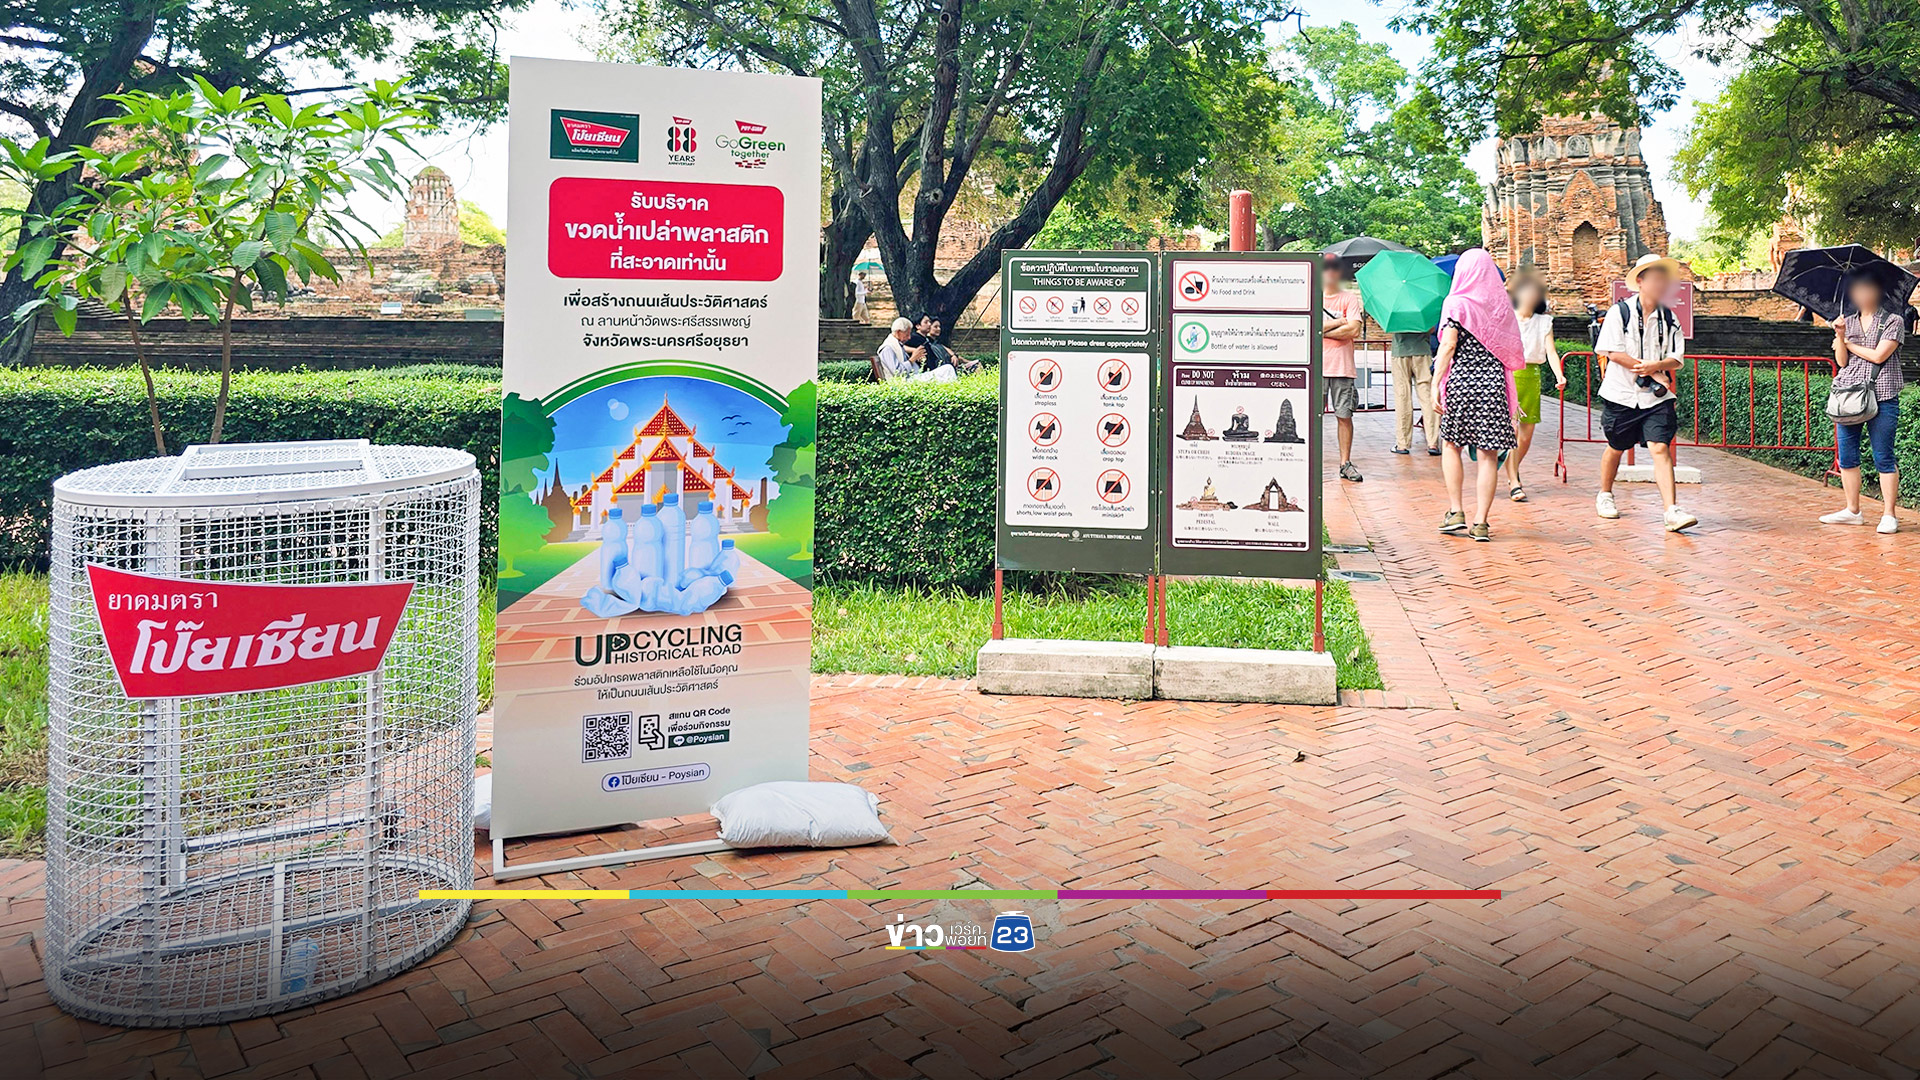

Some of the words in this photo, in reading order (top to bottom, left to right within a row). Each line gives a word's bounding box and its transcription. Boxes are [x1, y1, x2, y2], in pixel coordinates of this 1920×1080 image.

[668, 154, 696, 162] YEARS
[731, 149, 770, 160] together
[630, 191, 709, 211] รับบริจาค
[565, 212, 769, 243] ขวดน้ำเปล่าพลาสติก
[609, 246, 727, 271] ที่สะอาดเท่านั้น
[1032, 277, 1062, 287] THINGS
[1062, 278, 1074, 287] TO
[1075, 278, 1085, 287] BE
[1086, 278, 1114, 287] AWARE
[1114, 278, 1127, 287] OF
[564, 289, 768, 309] เพื่อสร้างถนนเส้นประวัติศาสตร์
[581, 316, 594, 326] ณ
[583, 333, 749, 351] จังหวัดพระนครศรีอยุธยา
[1067, 339, 1088, 347] Please
[1106, 341, 1149, 349] appropriately
[1192, 370, 1201, 379] DO
[1202, 370, 1215, 379] NOT
[1232, 370, 1250, 379] ห้าม
[108, 591, 218, 611] ยาดมตรา
[129, 613, 383, 674] โป๊ยเซียน
[614, 647, 699, 664] HISTORICAL
[703, 643, 742, 657] ROAD
[574, 663, 738, 687] ร่วมอัปเกรดพลาสติกเหลือใช้ในมือคุณ
[597, 679, 719, 700] ให้เป็นถนนเส้นประวัติศาสตร์
[668, 711, 691, 720] สแกน
[692, 709, 706, 718] QR
[708, 707, 731, 716] Code
[667, 720, 731, 733] เพื่อร่วมกิจกรรม
[686, 733, 725, 744] @Poysian
[668, 768, 705, 781] Poysian
